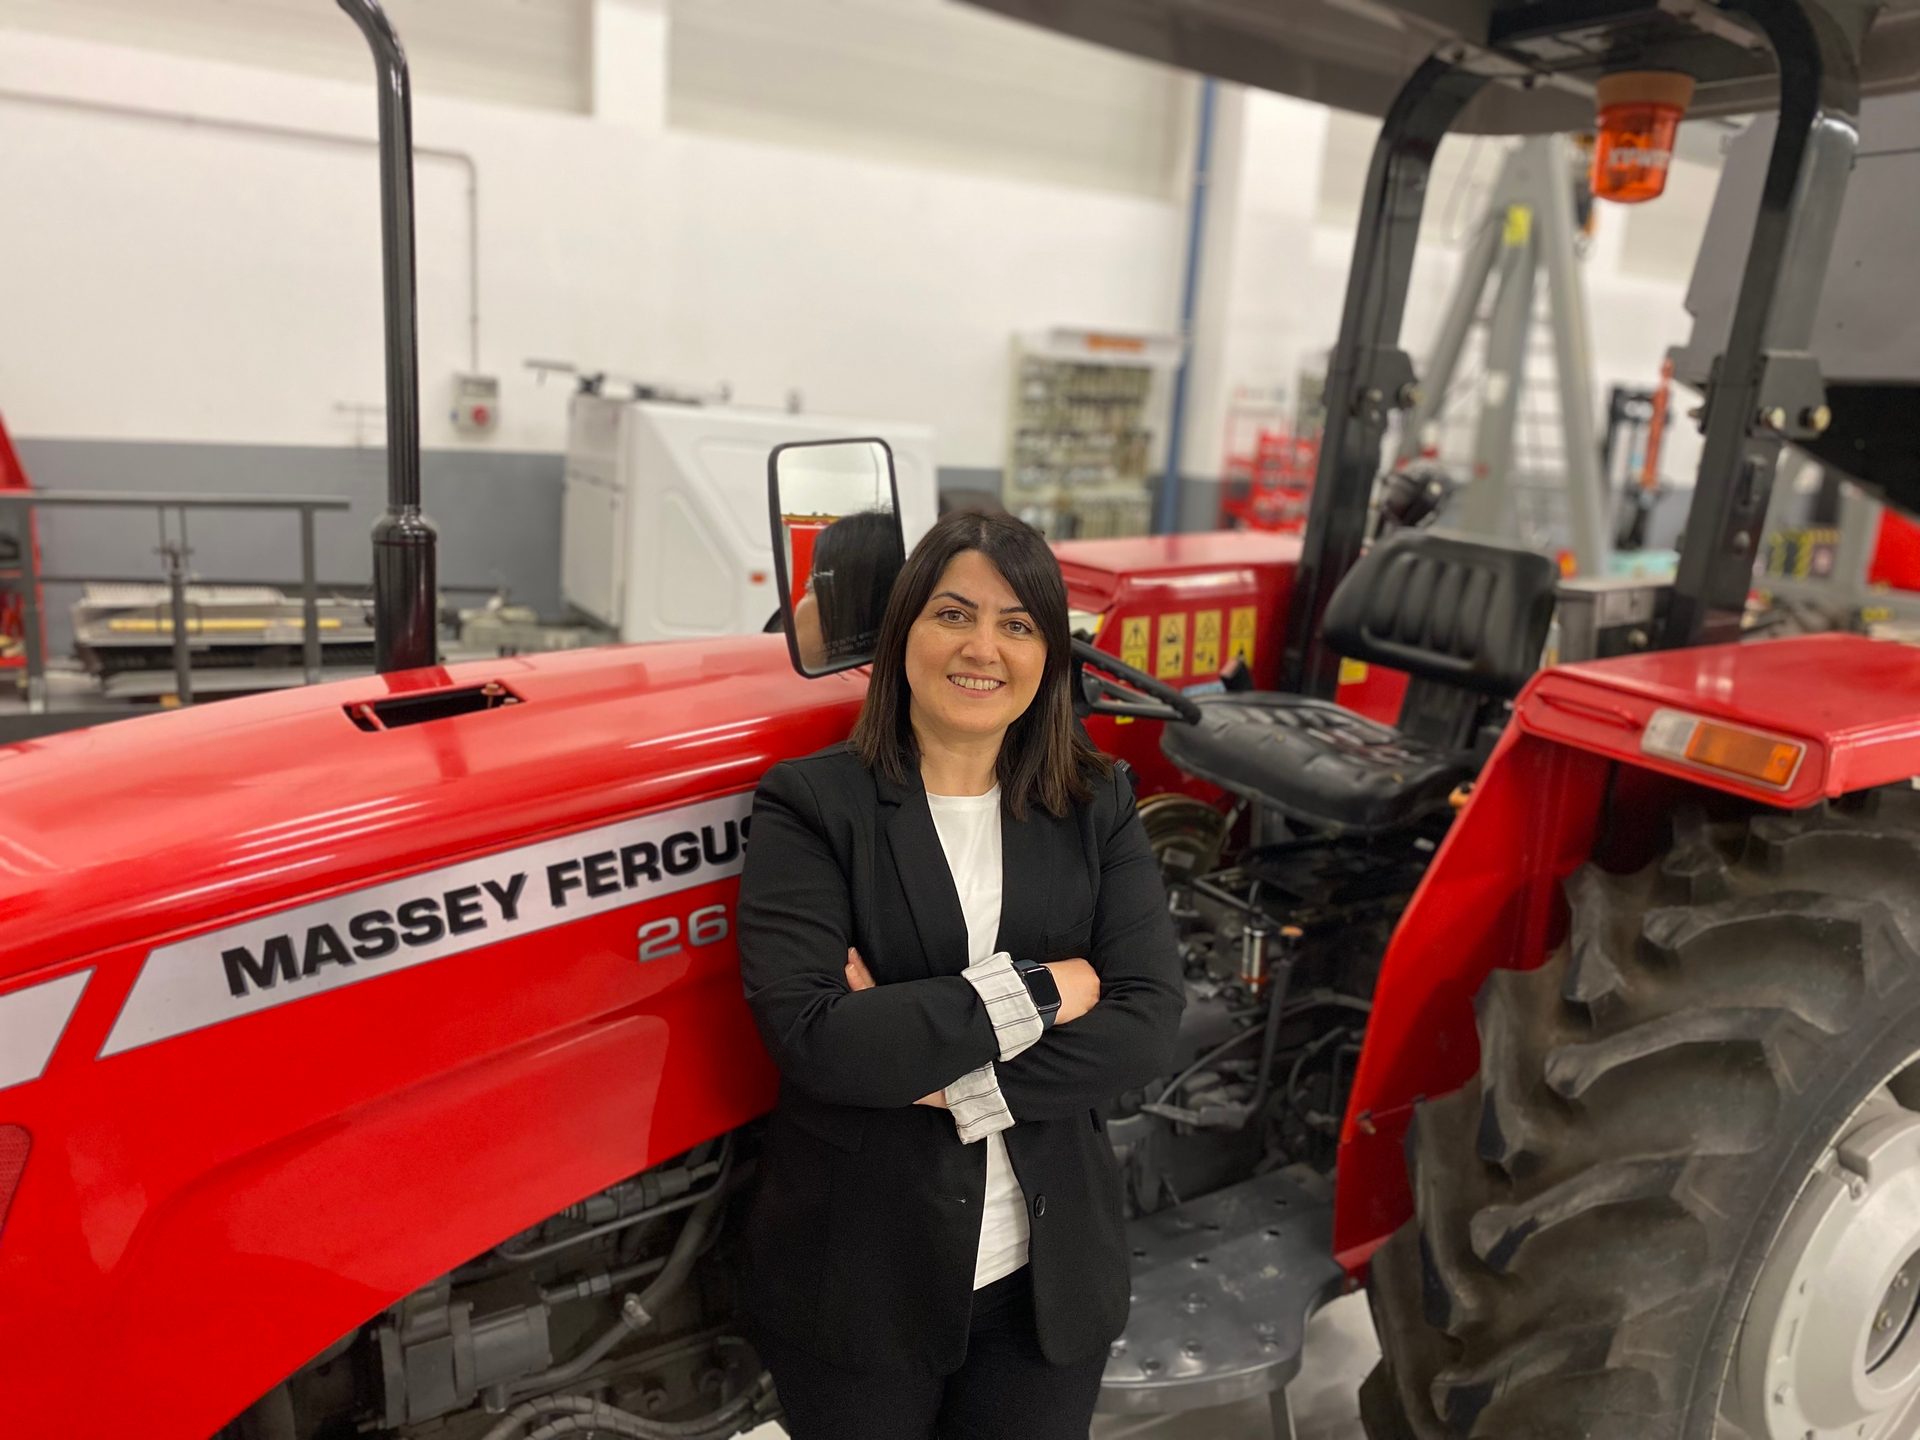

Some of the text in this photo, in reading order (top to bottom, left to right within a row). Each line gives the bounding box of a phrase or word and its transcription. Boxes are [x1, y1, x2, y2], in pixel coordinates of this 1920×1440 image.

[221, 815, 752, 998] MASSEY FERGU
[637, 904, 728, 963] 26
